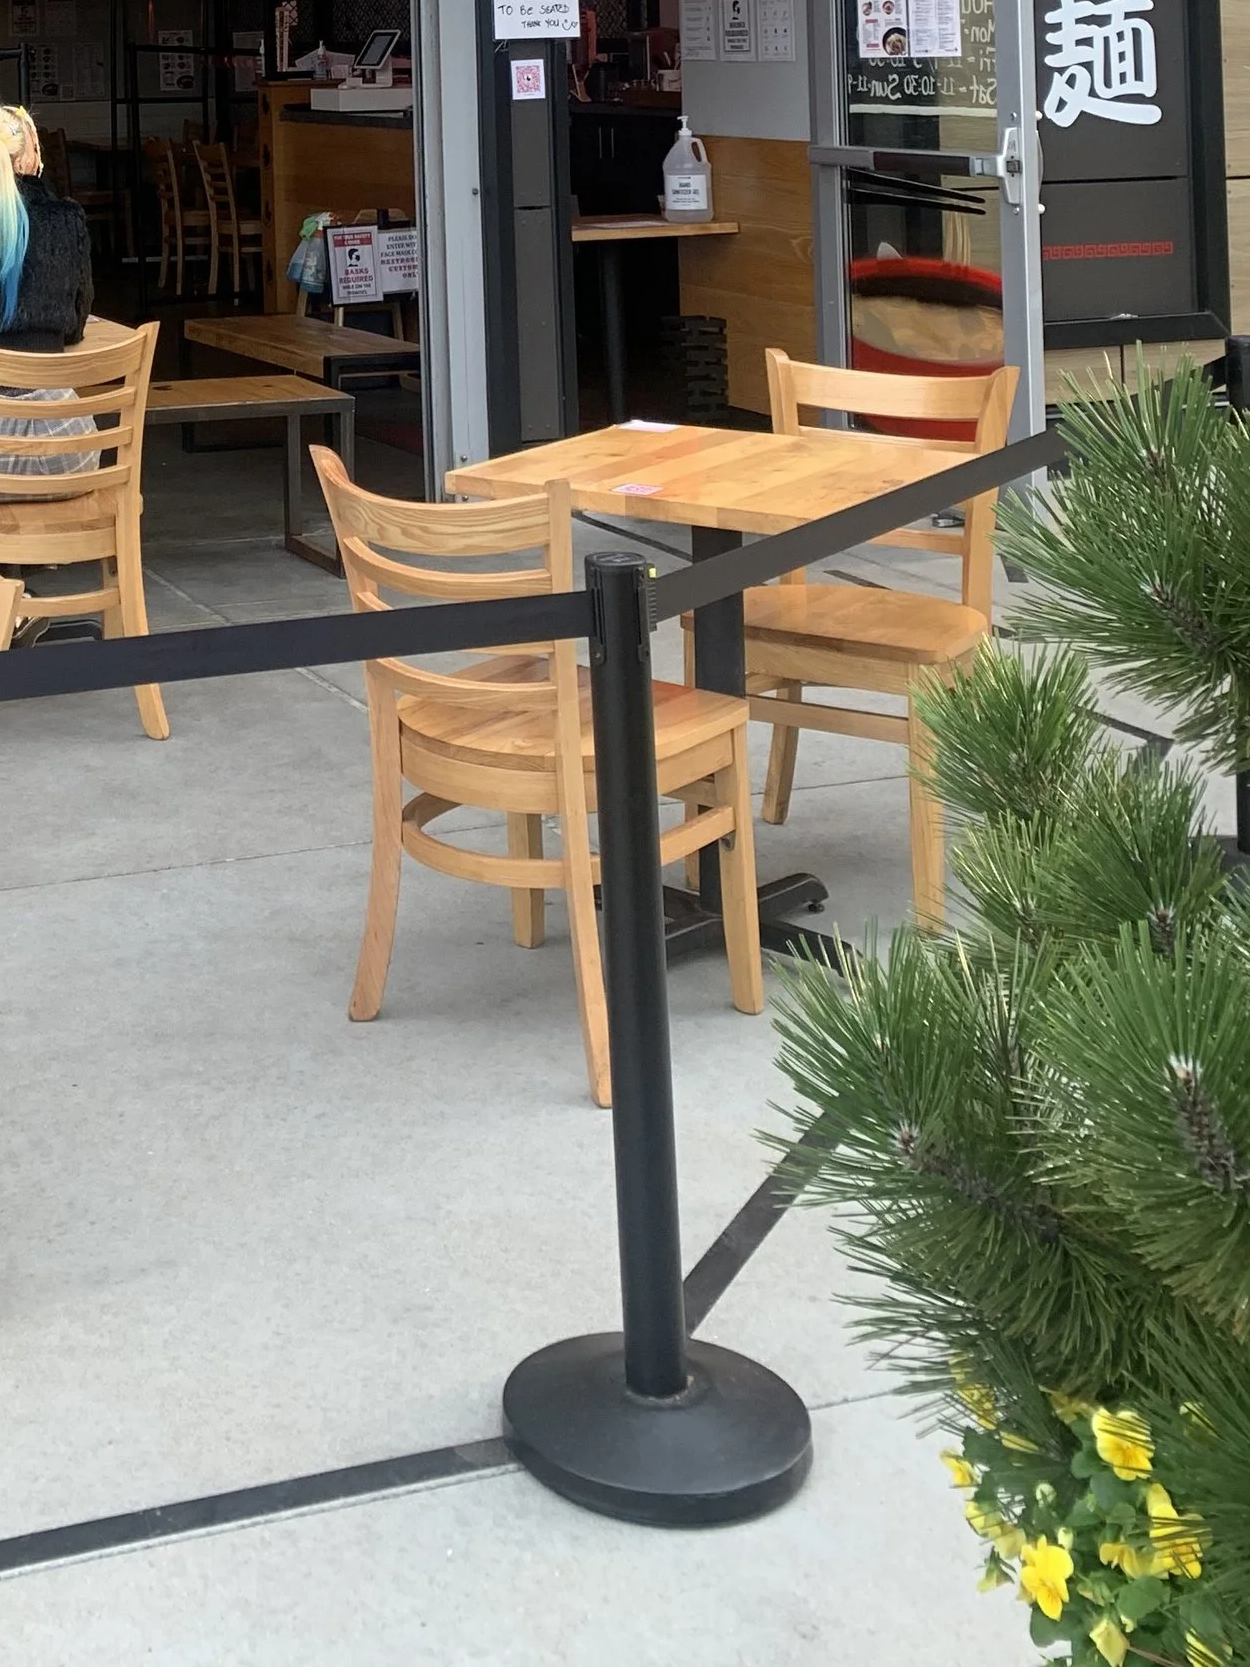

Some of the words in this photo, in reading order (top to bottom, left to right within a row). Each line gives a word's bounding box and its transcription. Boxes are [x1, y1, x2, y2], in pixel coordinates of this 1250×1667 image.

[498, 5, 513, 15] TO
[545, 19, 559, 28] YOU
[380, 257, 418, 265] RESTROO
